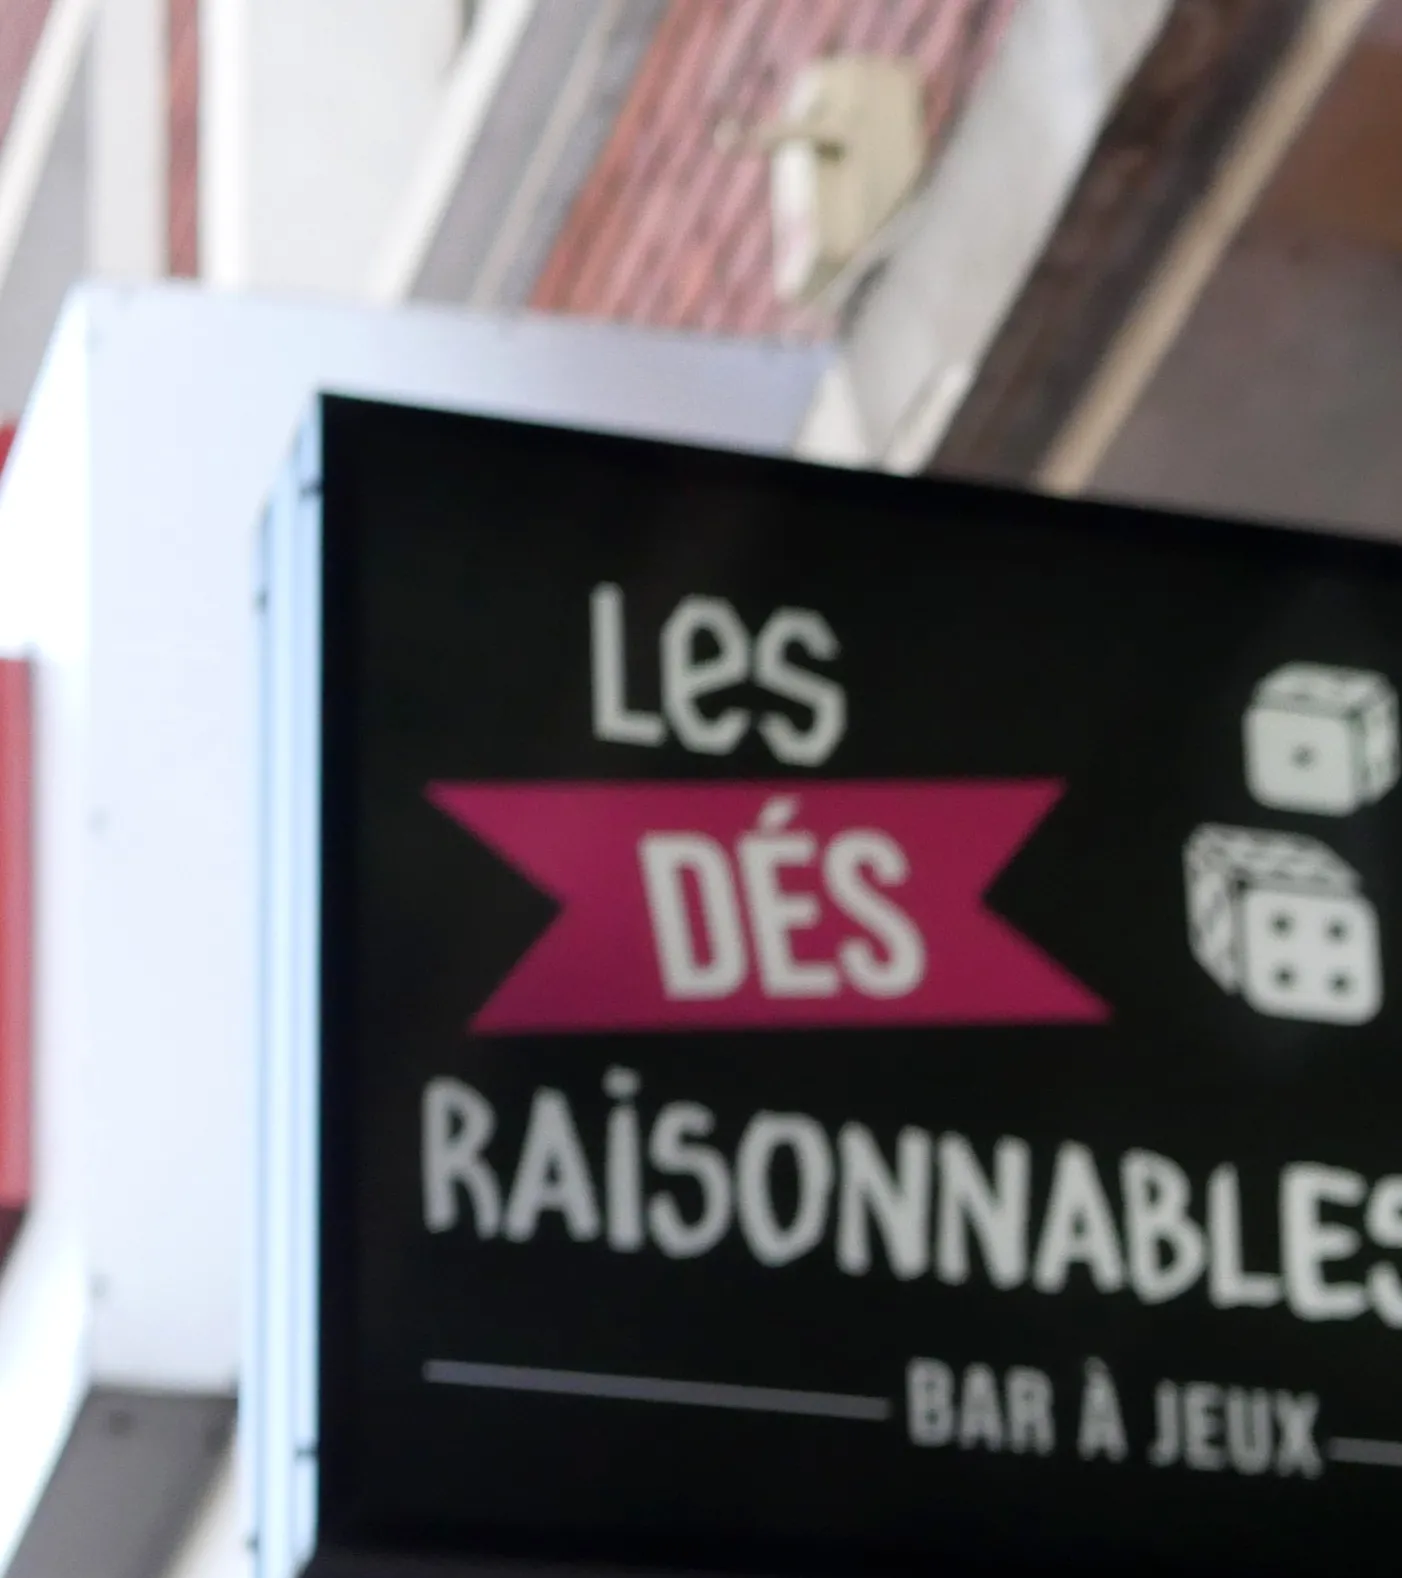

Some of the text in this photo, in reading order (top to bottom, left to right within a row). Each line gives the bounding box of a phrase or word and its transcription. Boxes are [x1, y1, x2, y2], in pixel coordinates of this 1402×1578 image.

[589, 584, 846, 768] Les
[636, 796, 926, 1000] DÉS
[904, 1355, 1323, 1478] BAR À JEUX
